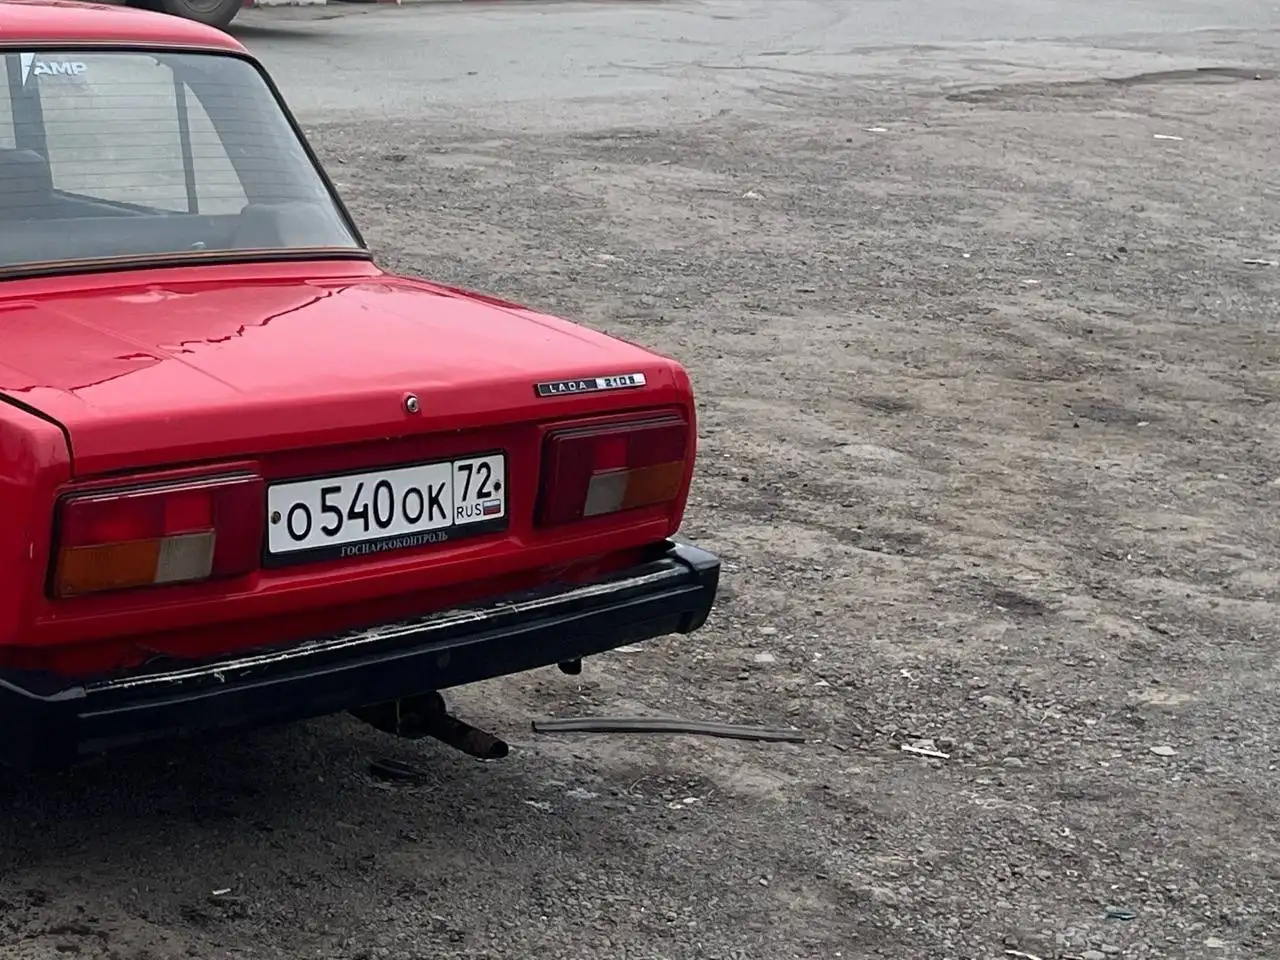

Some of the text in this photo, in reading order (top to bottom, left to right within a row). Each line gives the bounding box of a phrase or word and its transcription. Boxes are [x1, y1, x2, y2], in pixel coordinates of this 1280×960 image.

[549, 381, 588, 393] LADA
[286, 461, 493, 541] О540ОК 72
[456, 504, 483, 520] RUS
[340, 531, 450, 557] ГОСНАРКОКОНТРОЛЬ
